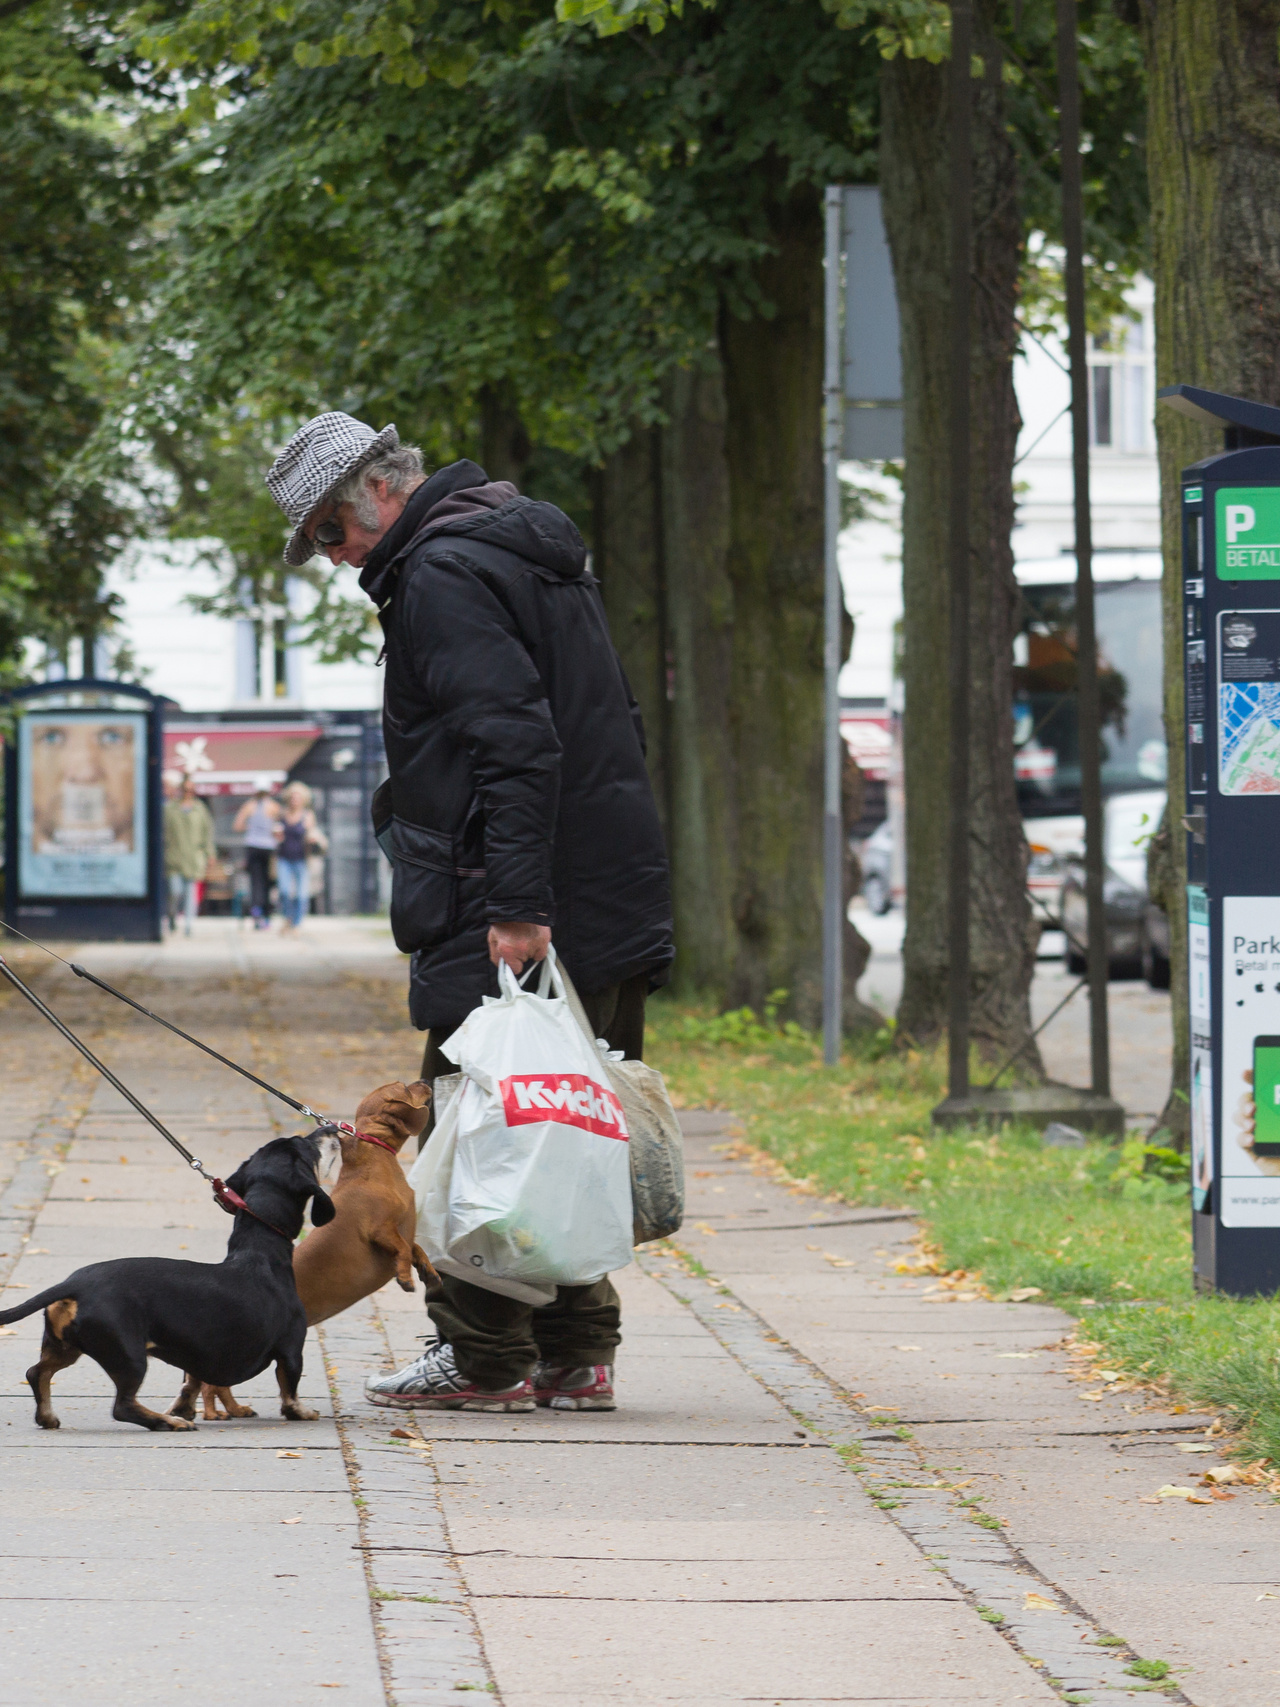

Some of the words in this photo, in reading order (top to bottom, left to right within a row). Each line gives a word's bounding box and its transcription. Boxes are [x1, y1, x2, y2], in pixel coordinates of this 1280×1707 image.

[1225, 504, 1256, 543] P
[1233, 935, 1280, 954] Park
[511, 1080, 628, 1136] Kvickly
